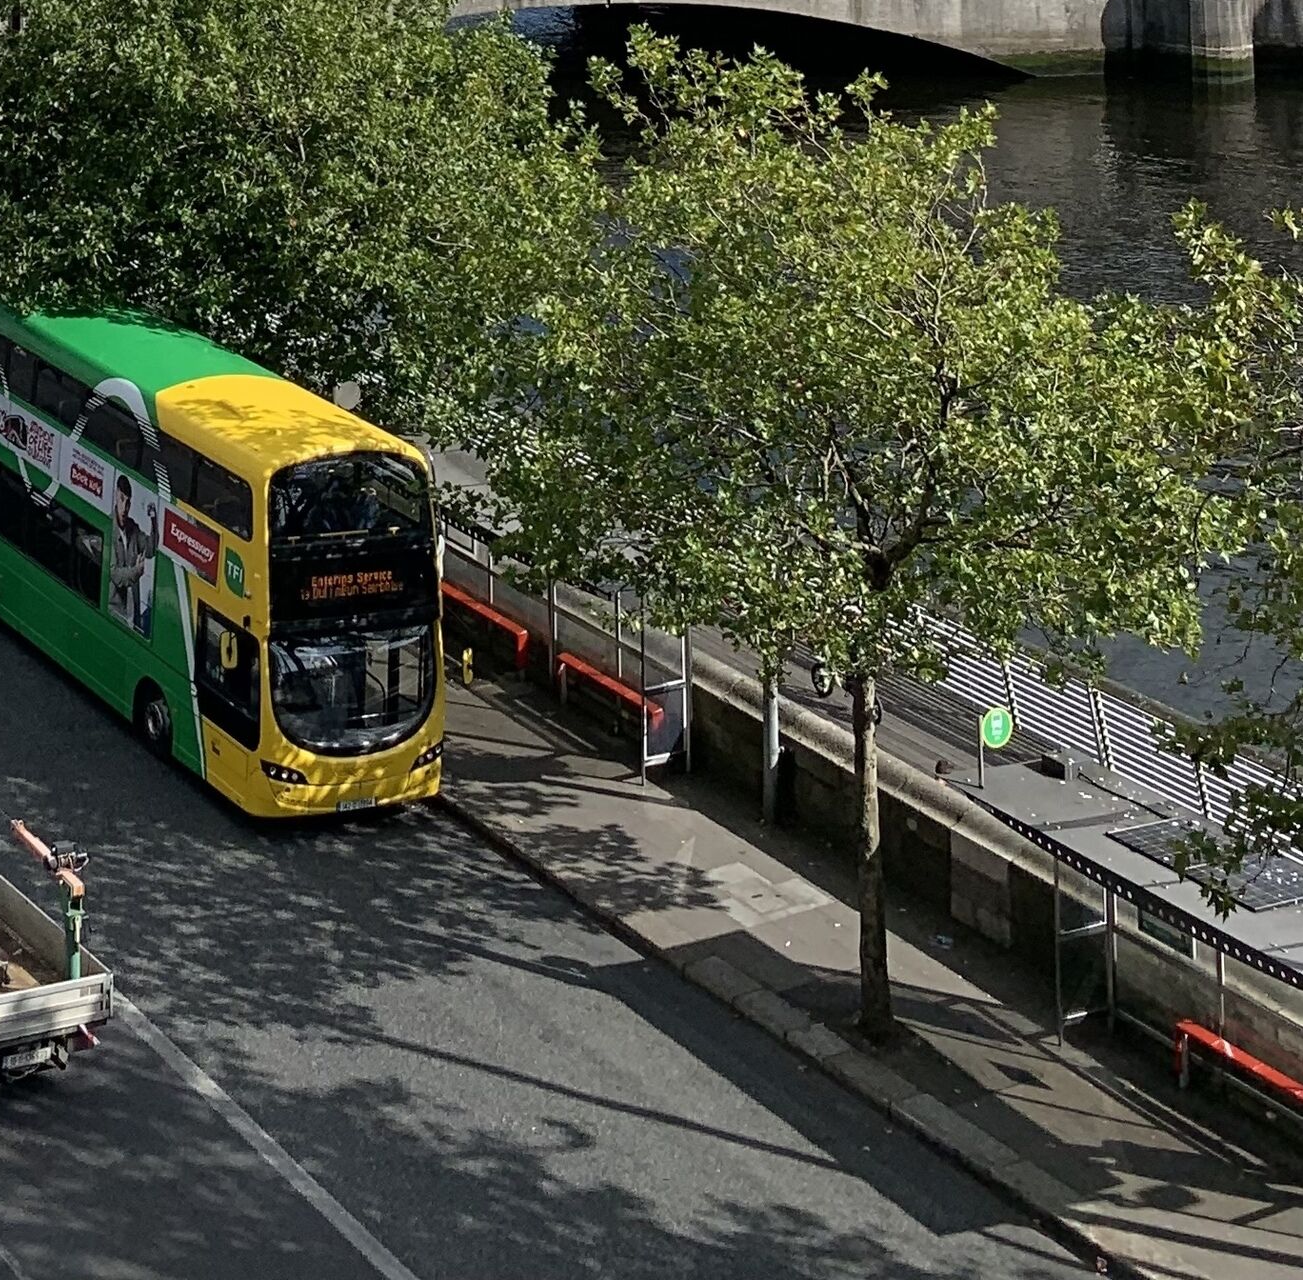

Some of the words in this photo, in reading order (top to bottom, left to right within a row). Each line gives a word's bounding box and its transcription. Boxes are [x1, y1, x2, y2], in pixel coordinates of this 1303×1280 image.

[171, 522, 215, 562] Expressway
[226, 560, 243, 583] TFI
[312, 574, 354, 587] Entering
[356, 570, 393, 583] Service
